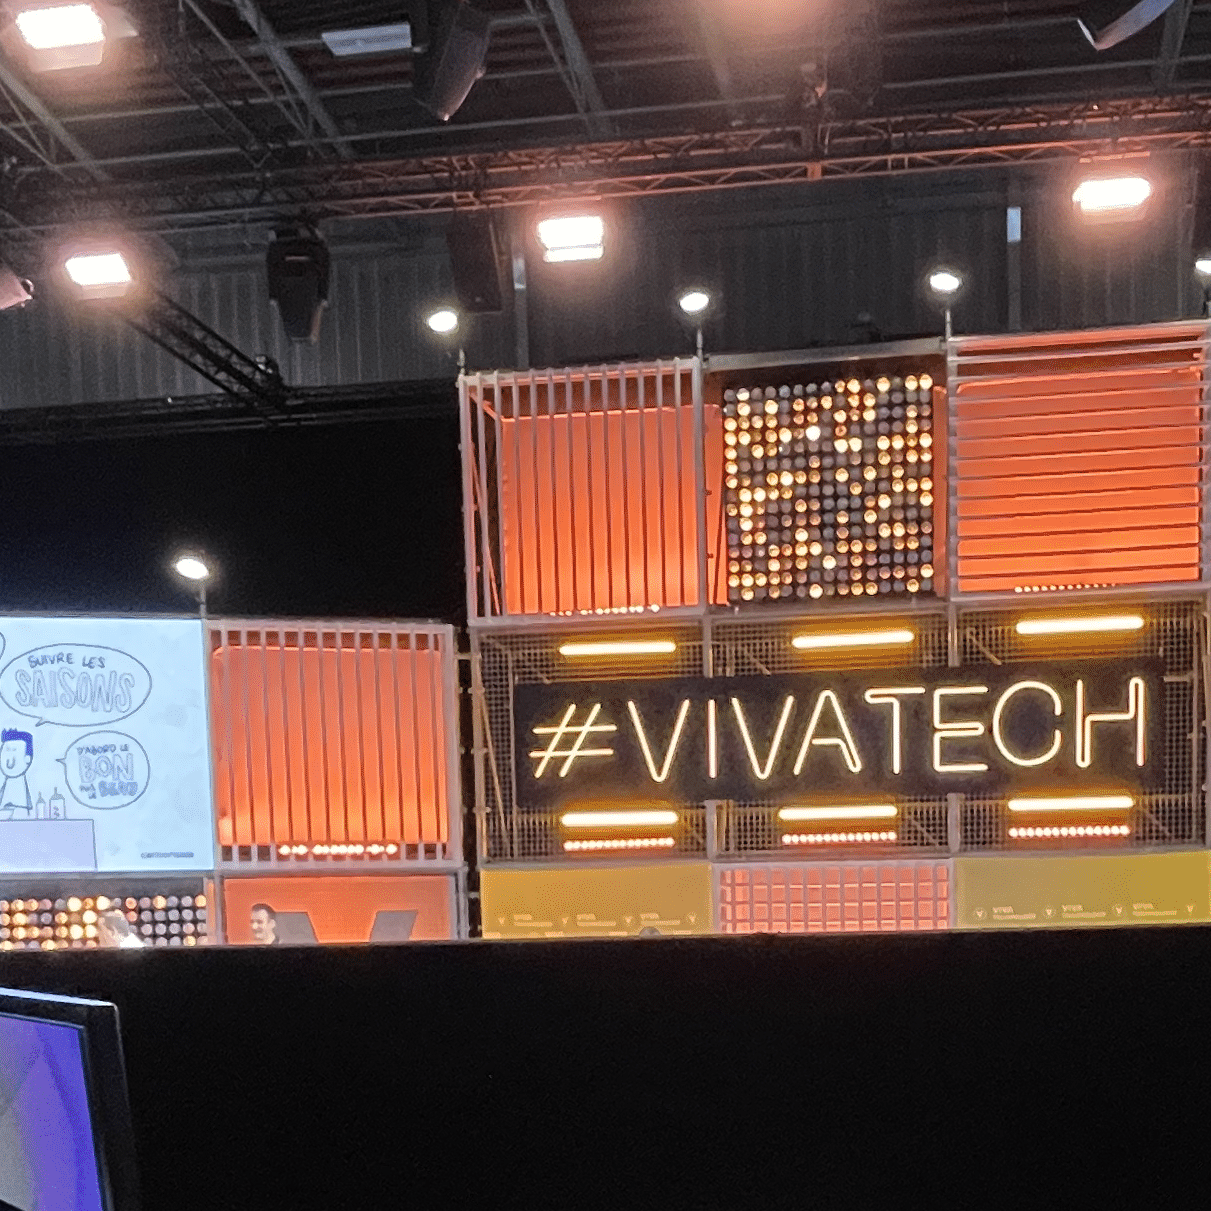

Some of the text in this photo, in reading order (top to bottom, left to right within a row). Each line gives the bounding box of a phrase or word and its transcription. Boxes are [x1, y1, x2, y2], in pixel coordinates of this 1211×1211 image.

[27, 652, 105, 669] SUIVRE LES
[15, 666, 136, 713] SAISONS
[527, 676, 1147, 783] #VIVATECH
[78, 753, 135, 783] BON
